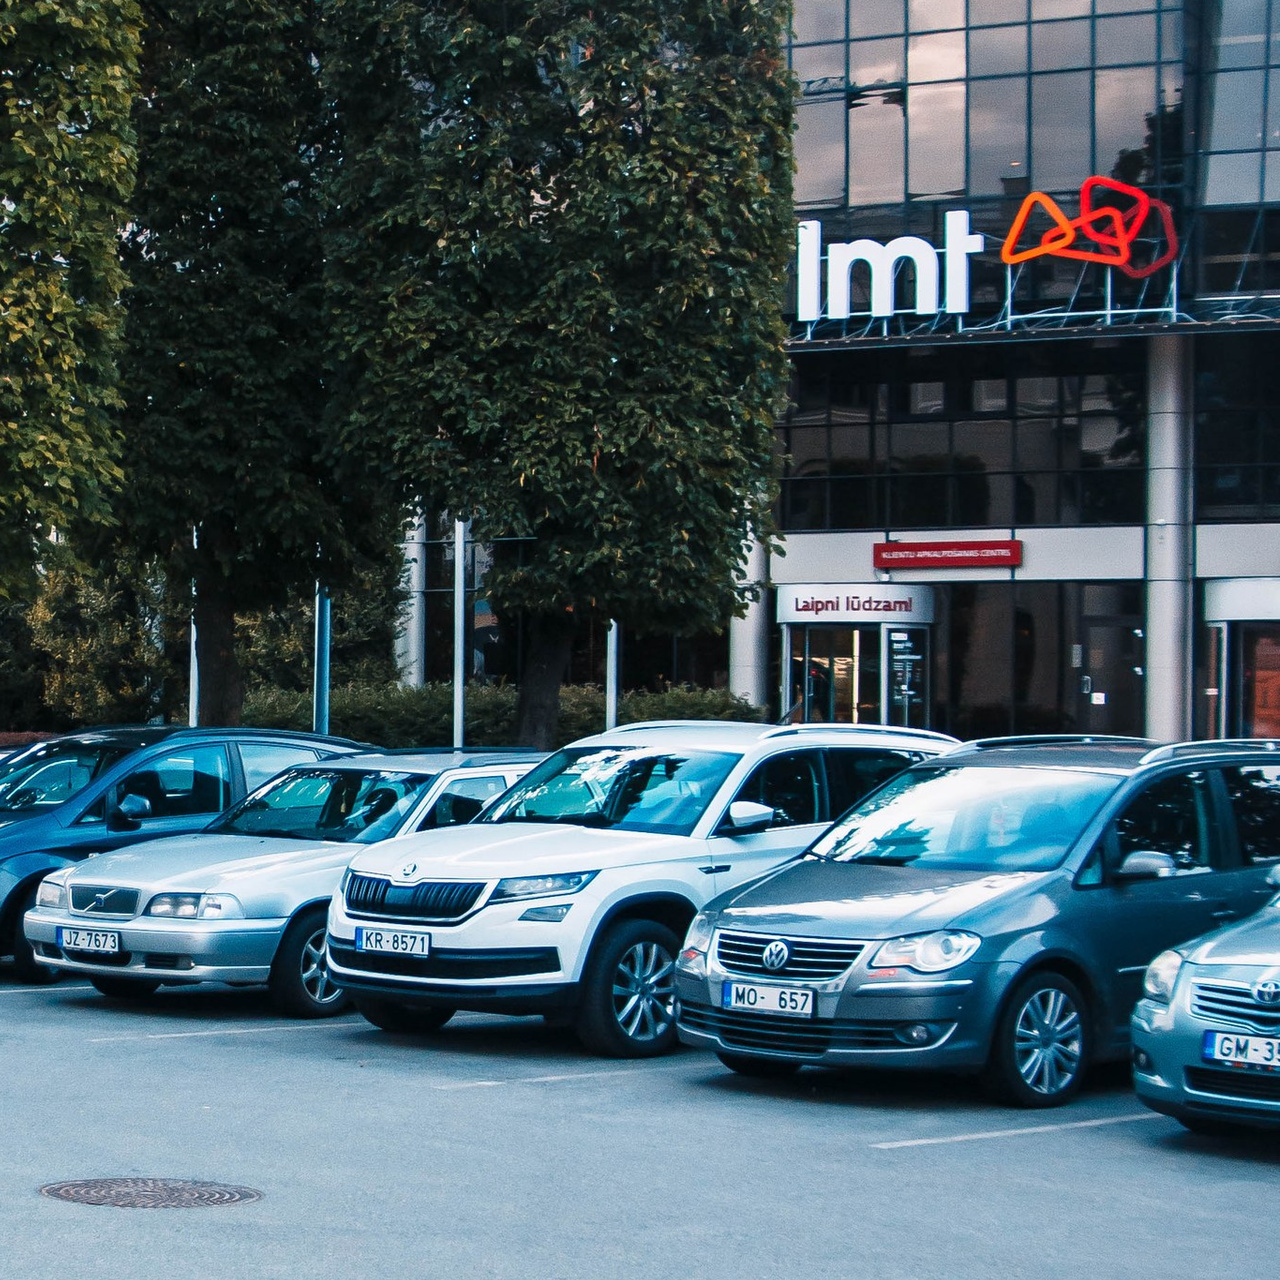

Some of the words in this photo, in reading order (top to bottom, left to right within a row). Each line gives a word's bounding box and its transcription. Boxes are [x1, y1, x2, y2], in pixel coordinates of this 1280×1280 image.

[797, 210, 984, 321] lmt
[795, 596, 840, 615] Laipni
[845, 596, 913, 612] lūdzam!
[65, 931, 117, 949] JZ-7673
[365, 931, 425, 953] KR-8571
[1220, 1036, 1280, 1062] GM-3
